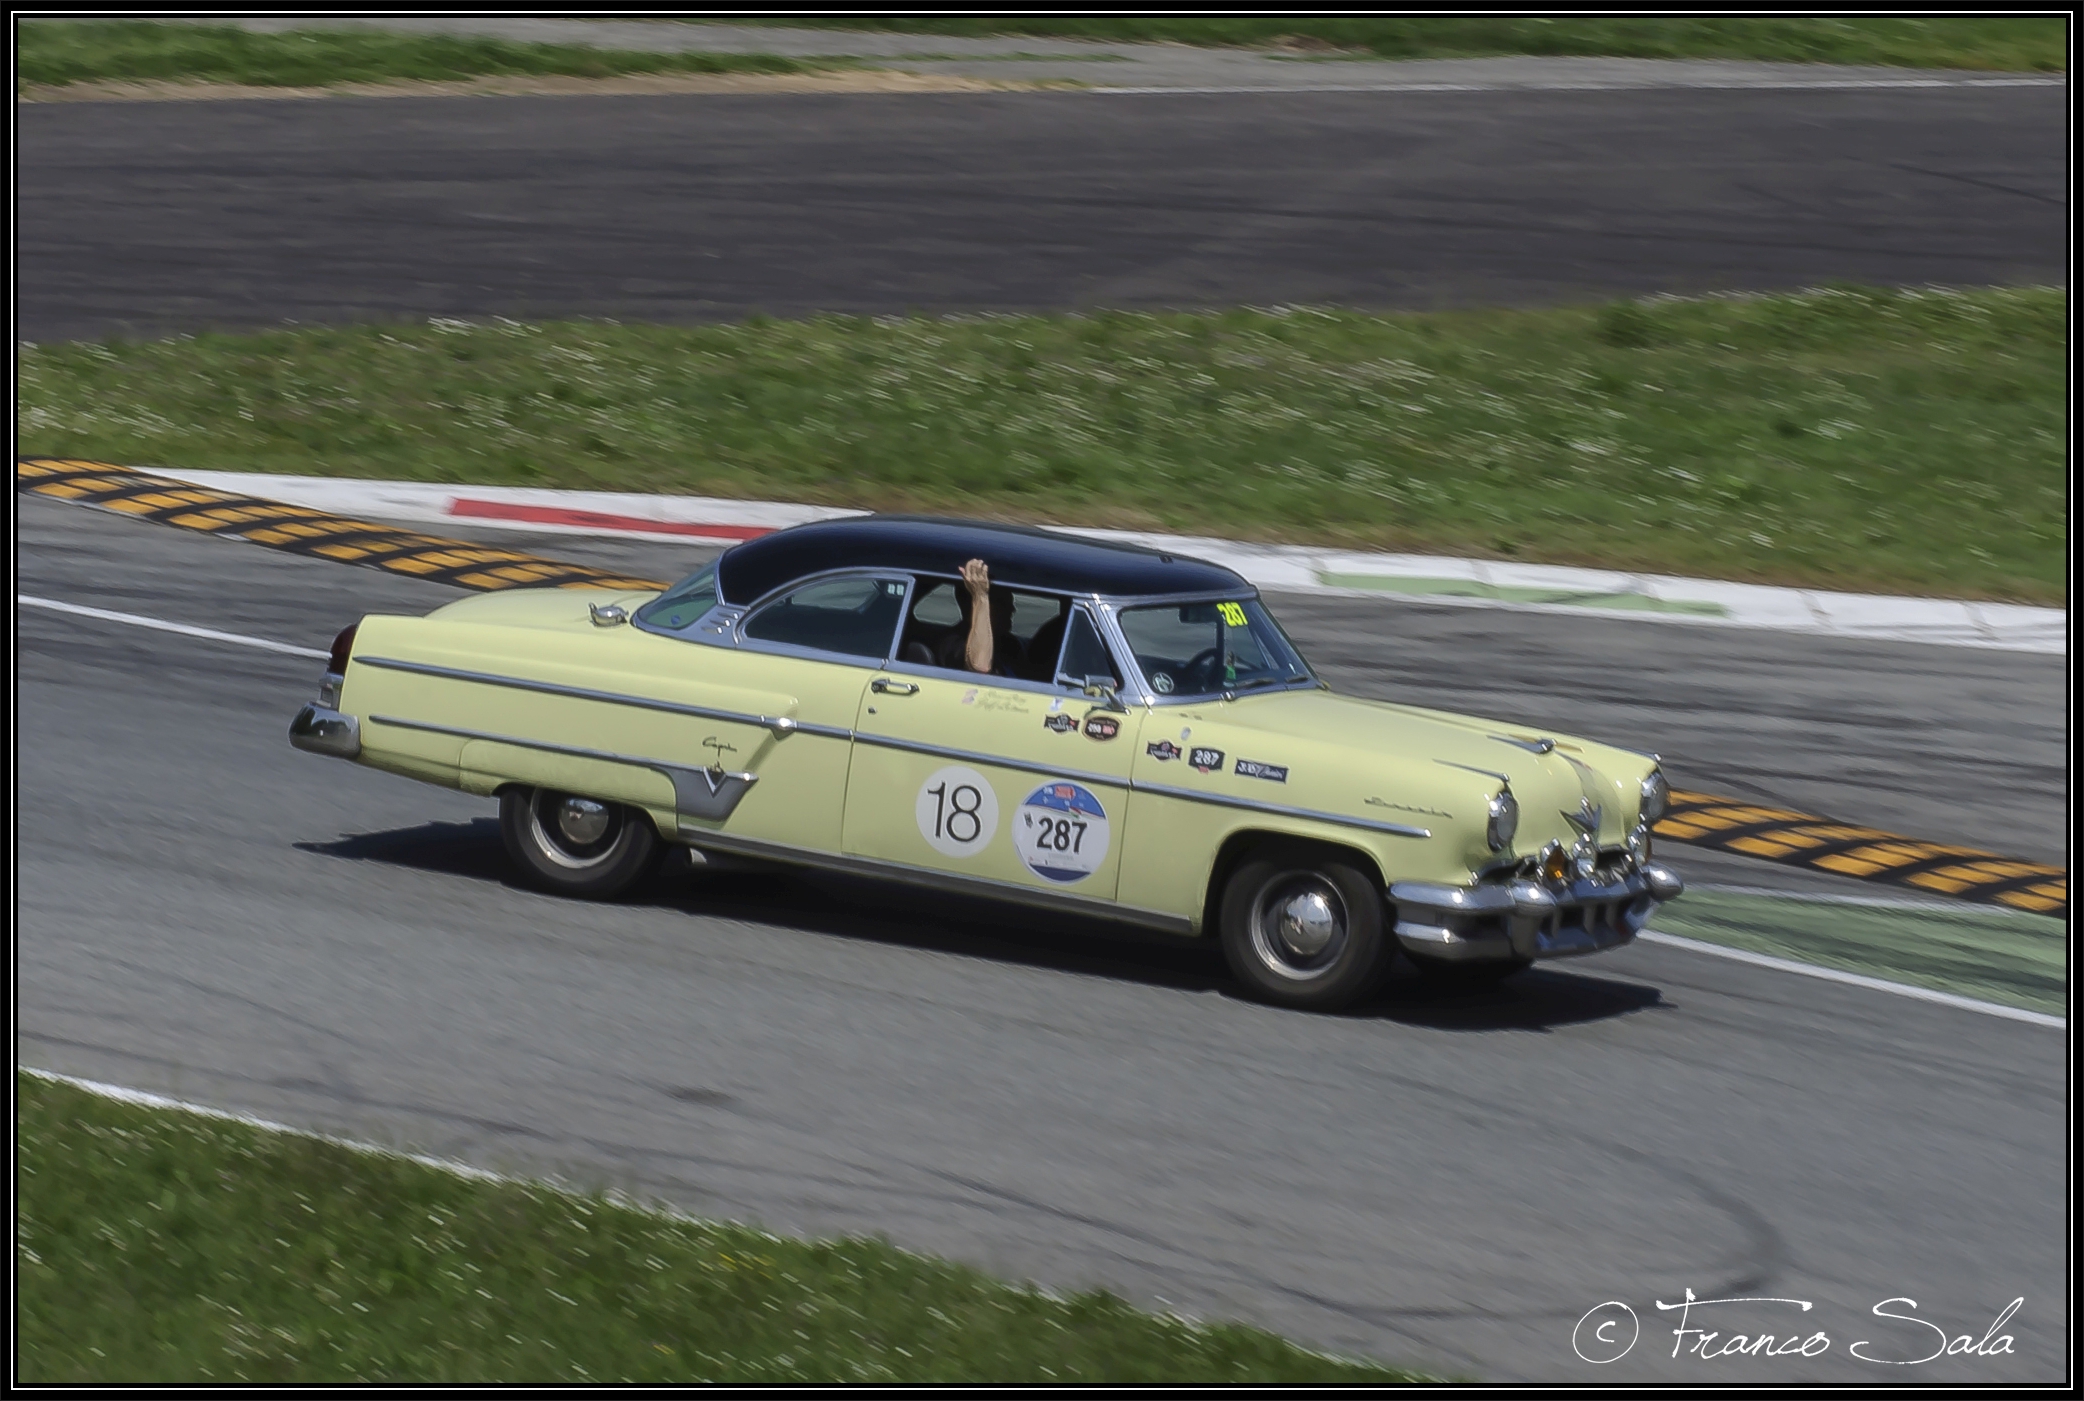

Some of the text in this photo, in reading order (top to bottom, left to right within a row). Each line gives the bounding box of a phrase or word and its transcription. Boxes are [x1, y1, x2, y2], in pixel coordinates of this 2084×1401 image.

[1217, 602, 1248, 627] 287
[1194, 750, 1219, 766] 287
[927, 781, 982, 843] 18
[1036, 816, 1088, 854] 287
